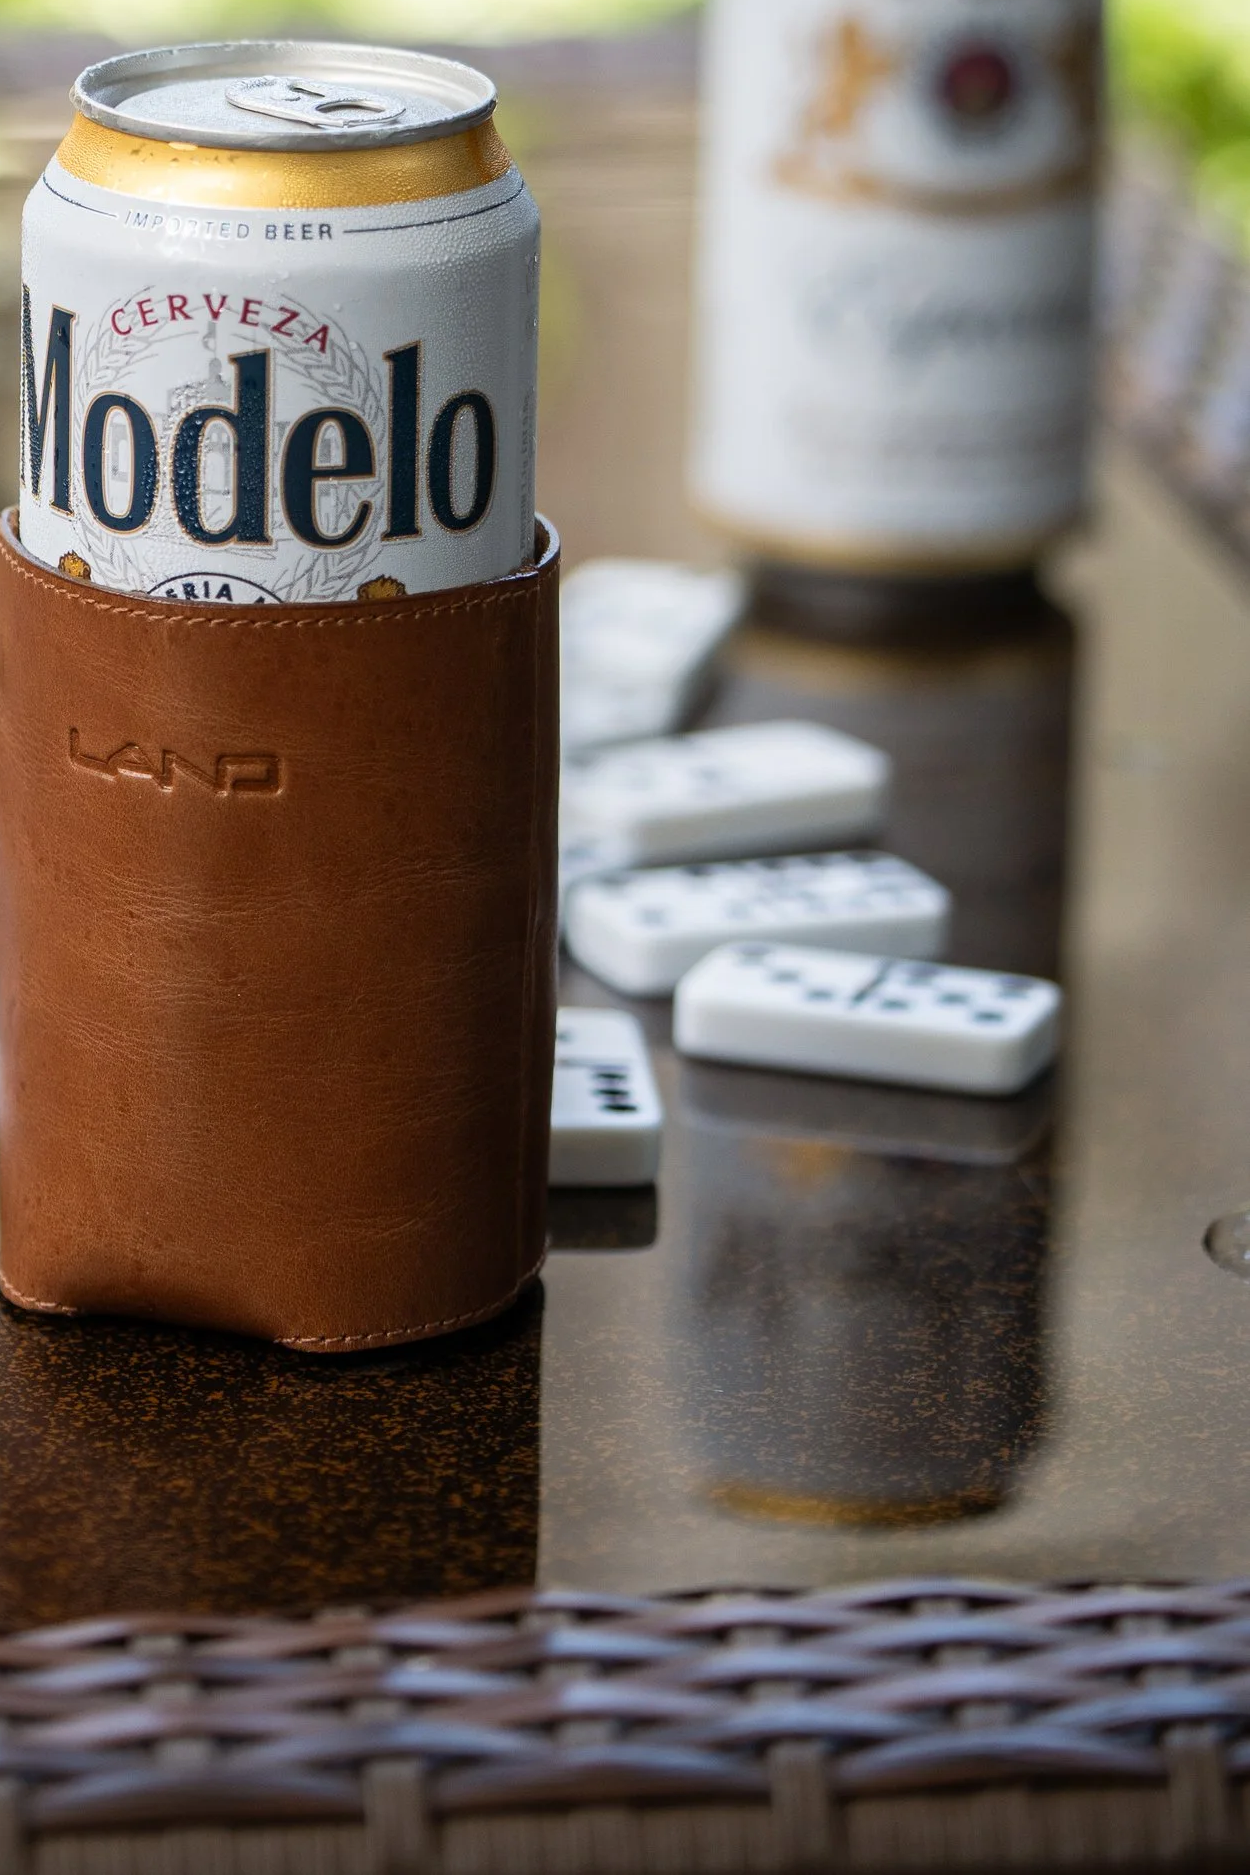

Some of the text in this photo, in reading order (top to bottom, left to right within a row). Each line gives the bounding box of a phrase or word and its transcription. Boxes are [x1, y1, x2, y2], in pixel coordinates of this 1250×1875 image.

[124, 210, 333, 241] IMPORTED BEER
[110, 293, 332, 355] CERVEZA
[20, 282, 497, 549] Modelo
[68, 726, 285, 798] LAND
